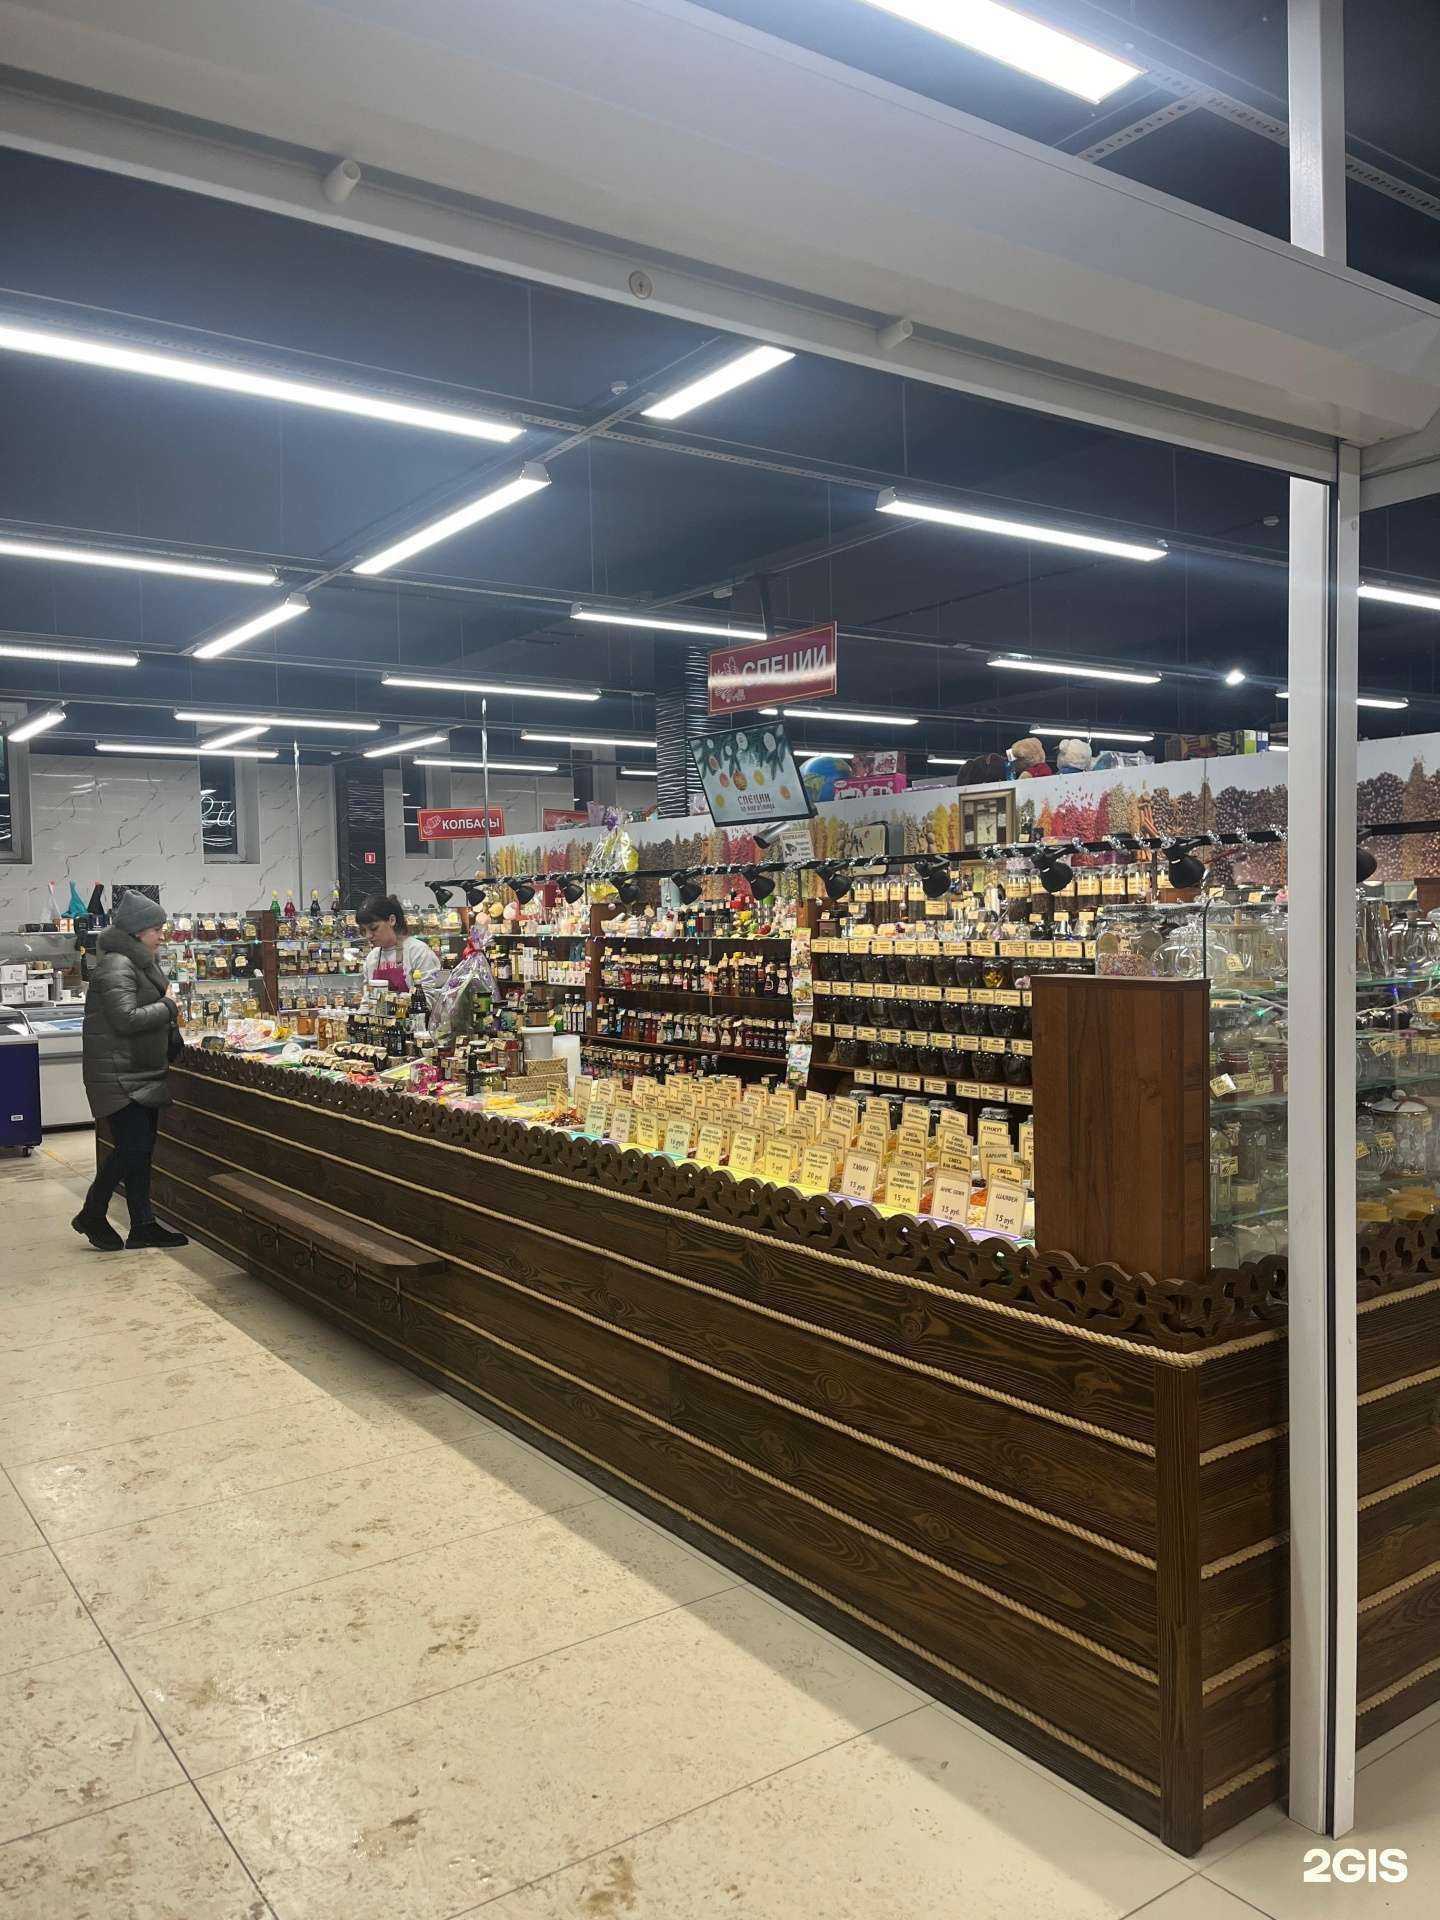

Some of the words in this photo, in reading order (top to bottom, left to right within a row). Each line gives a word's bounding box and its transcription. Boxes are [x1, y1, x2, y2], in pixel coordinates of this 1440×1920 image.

[743, 645, 827, 687] СПЕЦИИ
[738, 793, 771, 805] СПЕЦИИ
[442, 818, 500, 830] КОЛБАСЫ
[942, 1205, 950, 1213] 15
[995, 1214, 1003, 1222] 15
